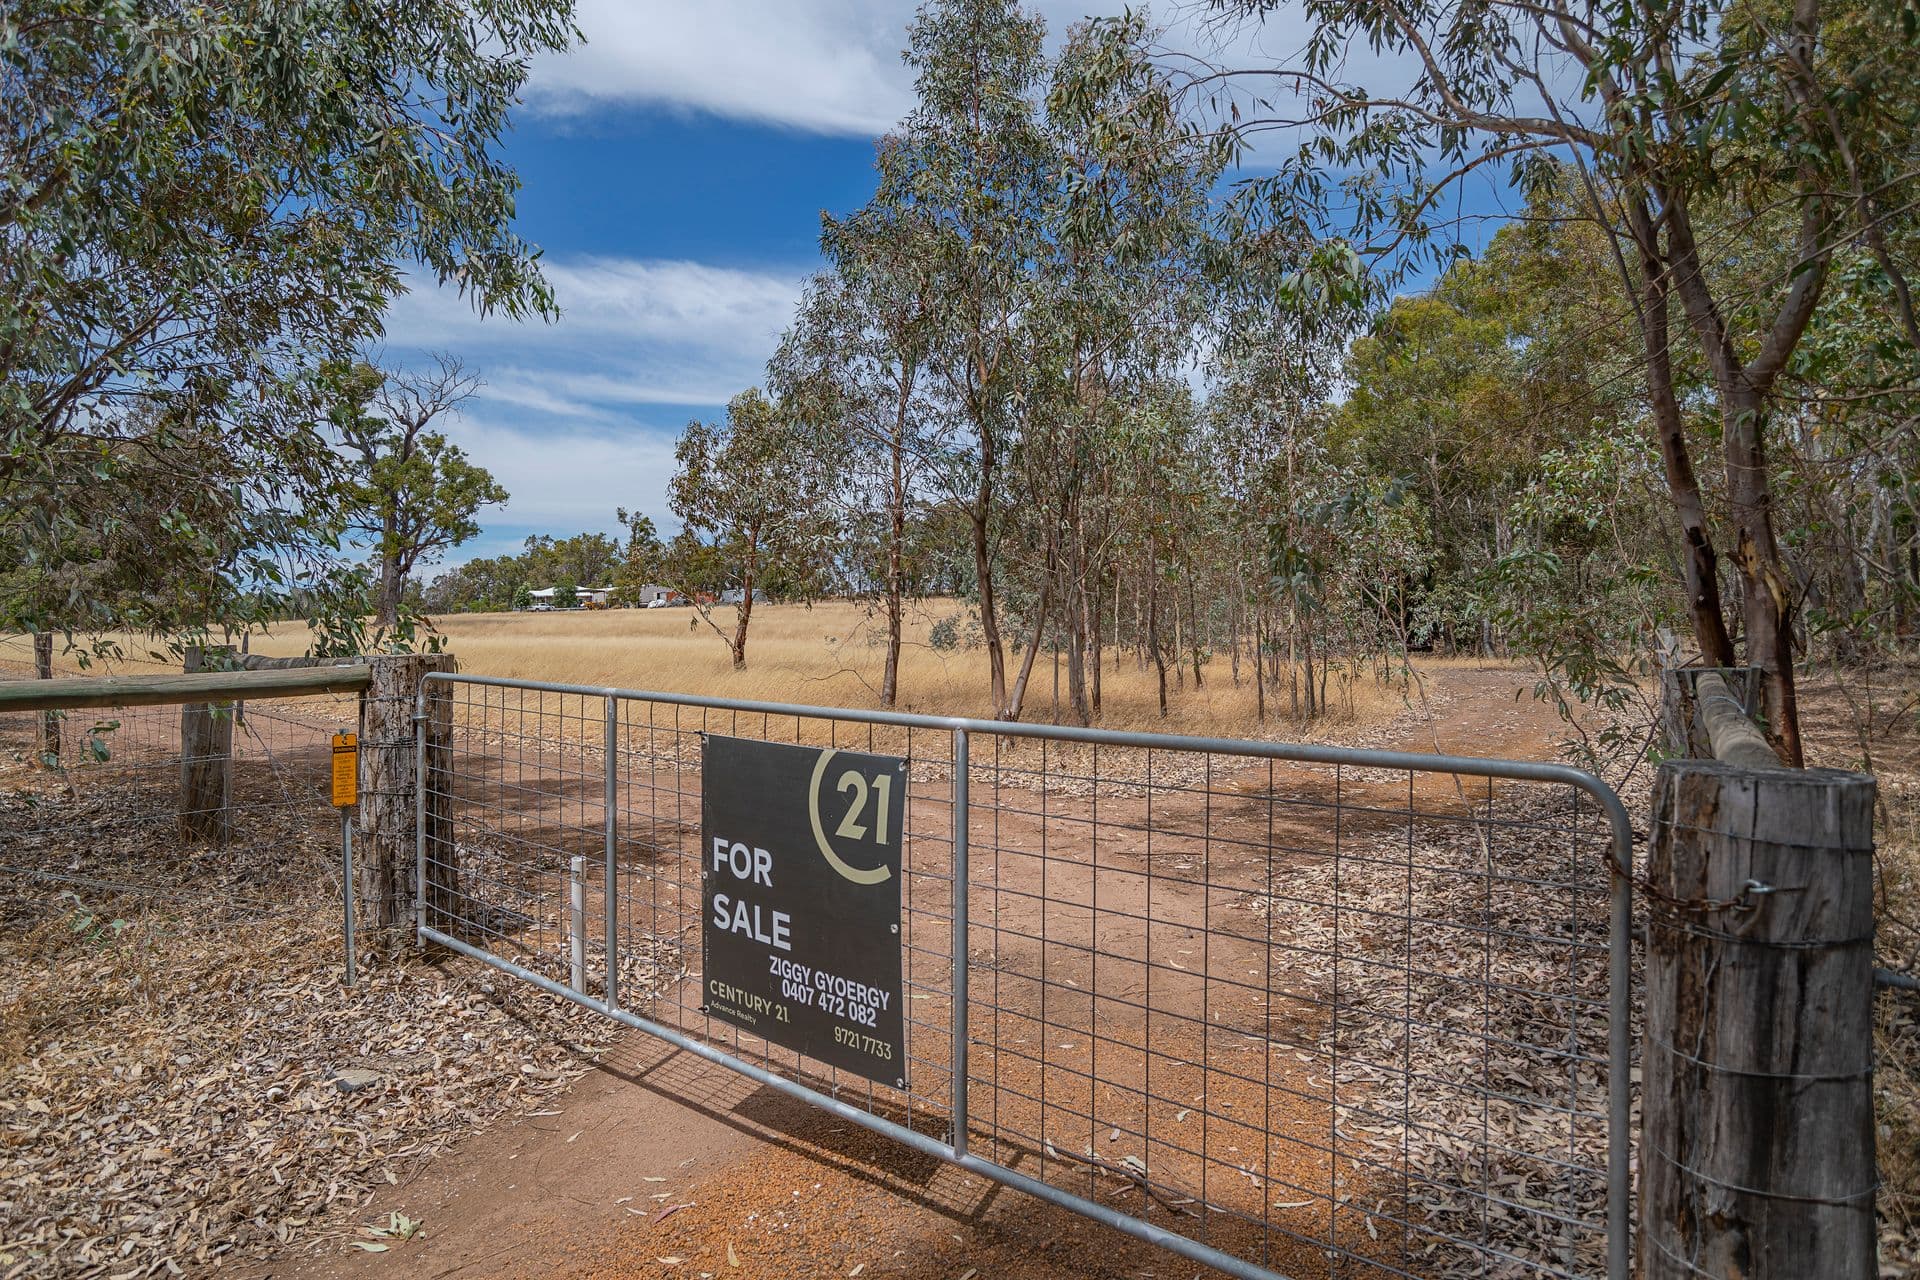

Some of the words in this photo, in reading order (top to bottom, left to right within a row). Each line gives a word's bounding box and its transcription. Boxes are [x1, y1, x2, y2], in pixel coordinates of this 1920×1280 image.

[835, 770, 891, 845] 21
[713, 837, 773, 888] FOR
[713, 893, 792, 951] SALE
[710, 979, 772, 1016] CENTURY
[775, 1004, 790, 1023] 21
[769, 955, 811, 985] ZIGGY
[814, 971, 890, 1011] GYOERGY
[782, 979, 814, 1006] 0407
[818, 992, 845, 1017] 472
[848, 1002, 877, 1028] 082
[834, 1026, 860, 1049] 9721
[862, 1035, 892, 1060] 7733
